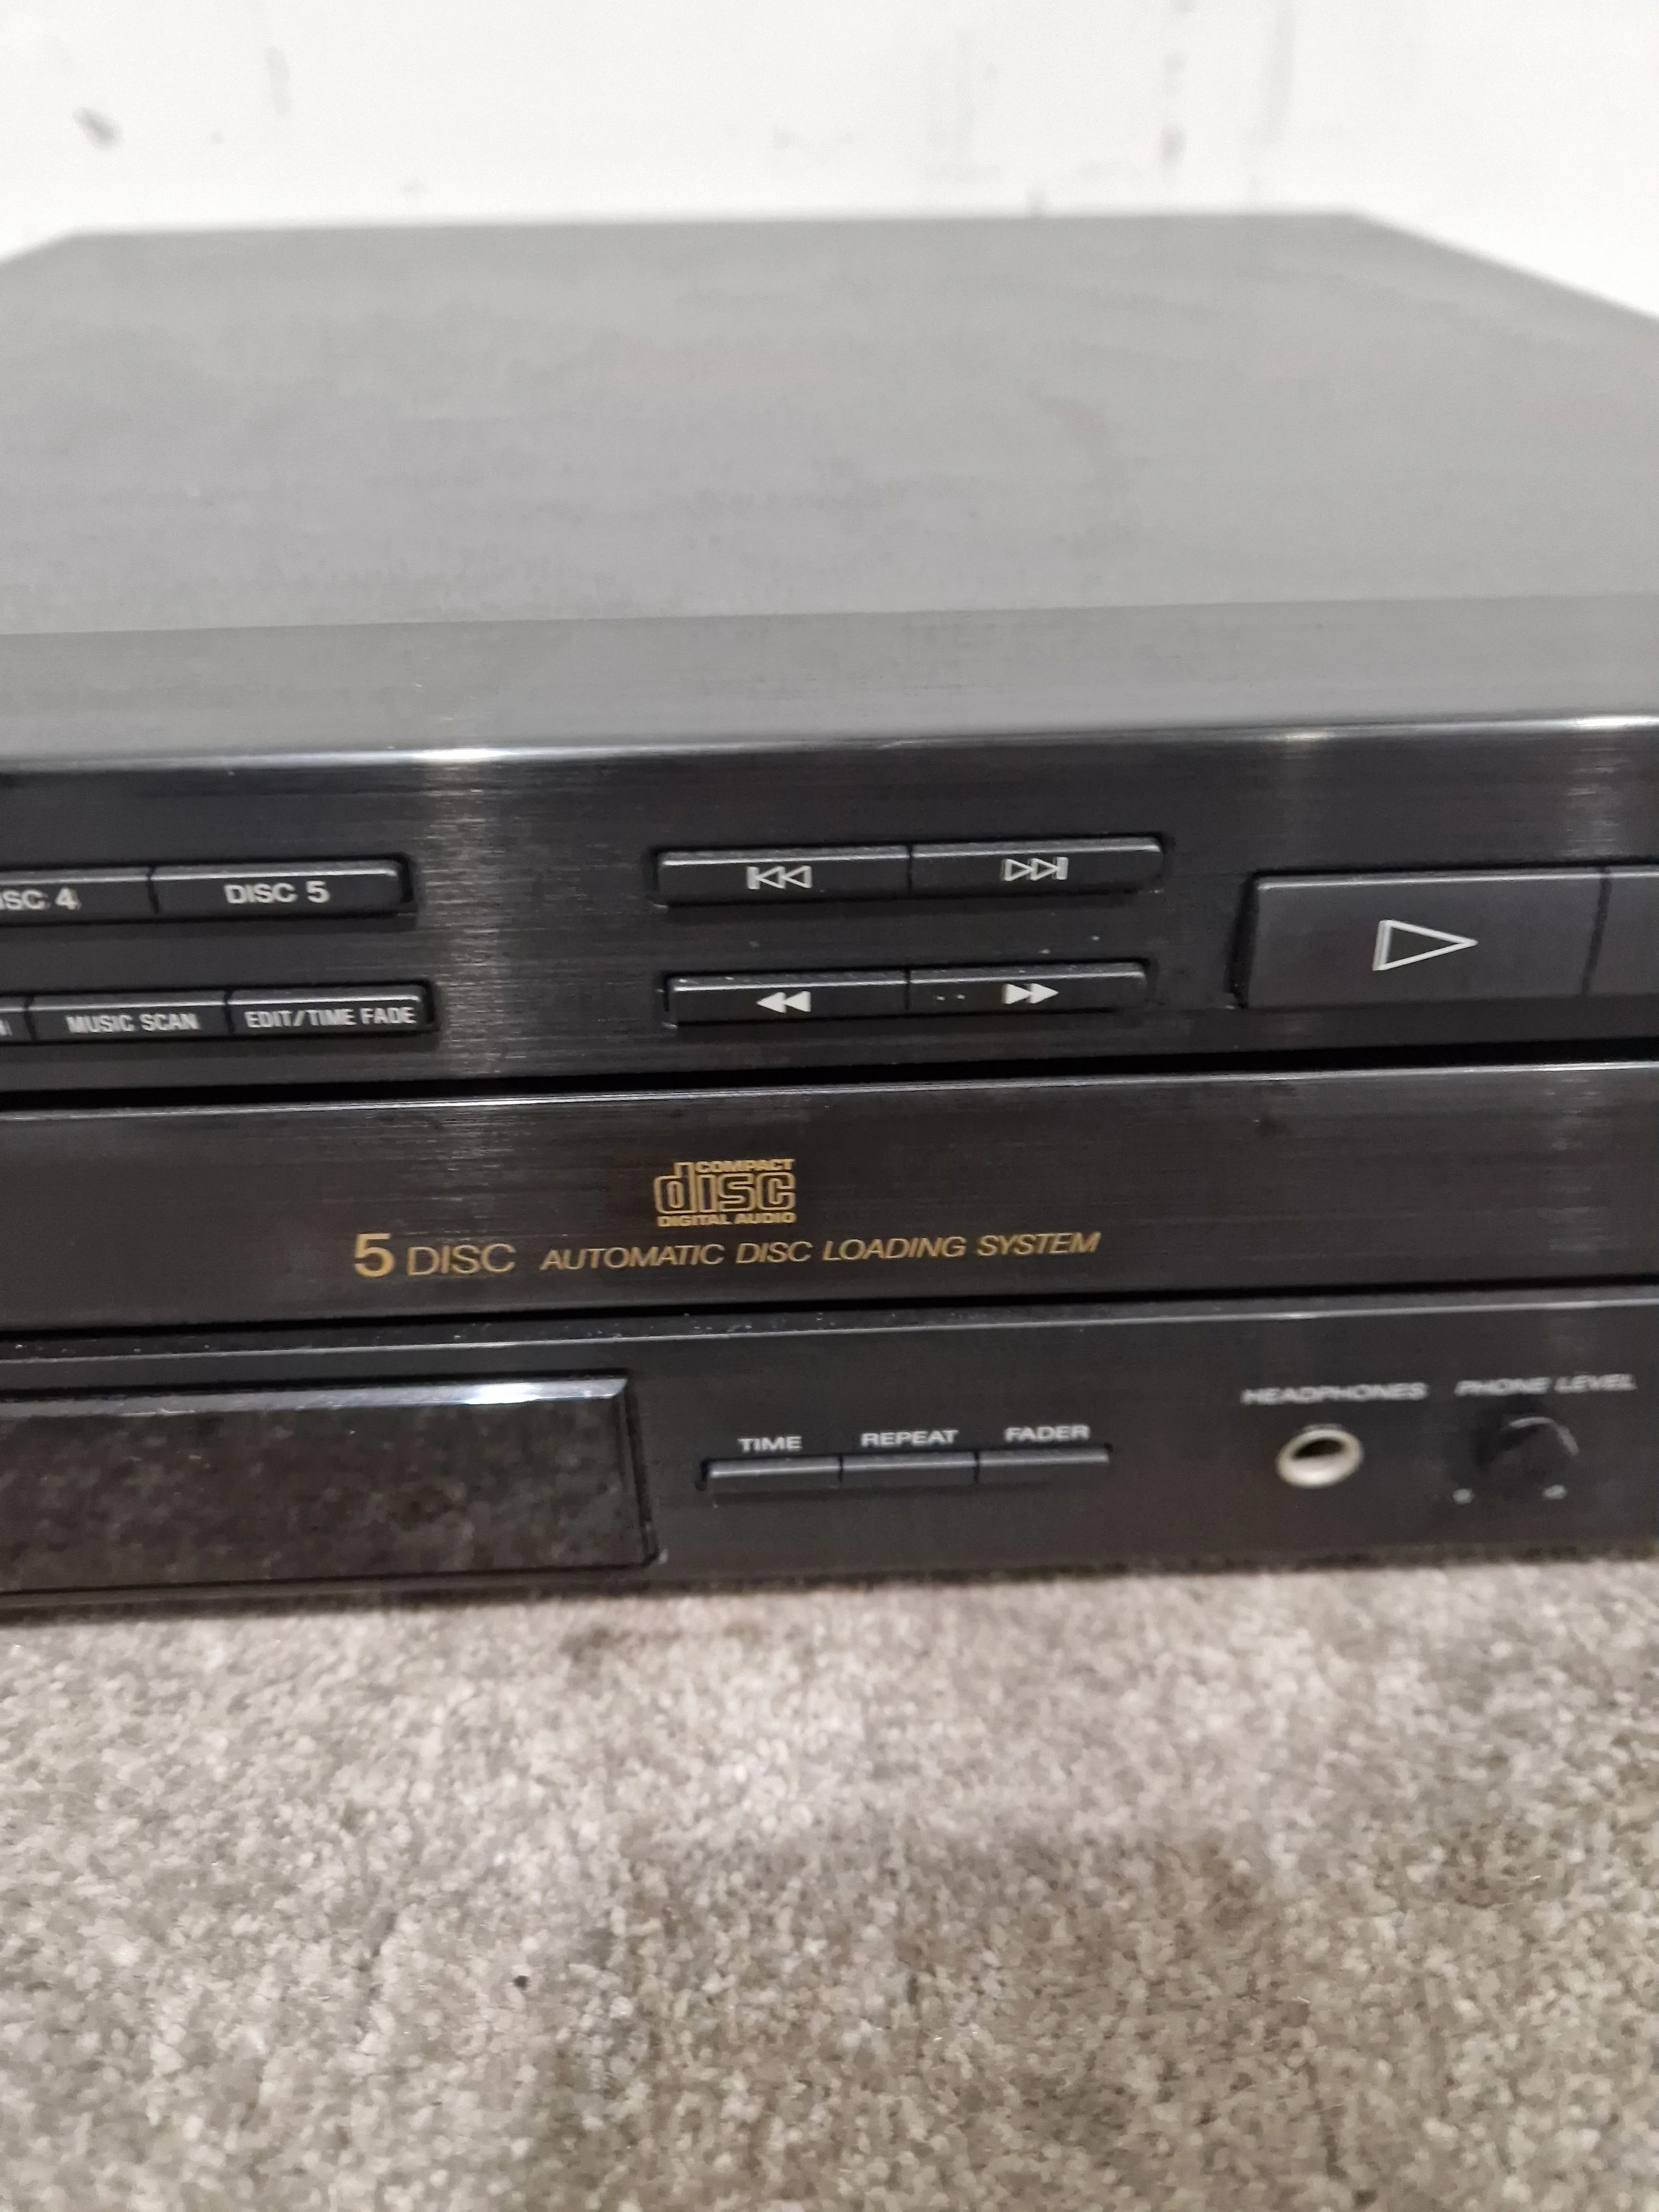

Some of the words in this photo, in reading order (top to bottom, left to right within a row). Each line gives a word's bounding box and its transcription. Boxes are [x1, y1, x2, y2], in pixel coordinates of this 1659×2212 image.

[55, 886, 81, 910] 4
[224, 883, 298, 905] DISC
[306, 880, 331, 904] 5
[65, 1015, 135, 1034] MUSIC
[140, 1013, 200, 1032] SCAN
[244, 1009, 356, 1029] EDIT/TIME
[359, 1006, 418, 1025] FADE
[653, 1162, 796, 1214] disc
[354, 1233, 395, 1278] 5
[407, 1243, 517, 1276] DISC
[539, 1244, 725, 1270] AUTOMATIC
[735, 1240, 814, 1264] DISC
[822, 1235, 967, 1262] LOADING
[977, 1232, 1102, 1257] SYSTEM
[1240, 1382, 1430, 1405] HEADPHONES
[1454, 1378, 1551, 1396] PHONE
[1554, 1373, 1637, 1394] LEVEL
[860, 1429, 959, 1448] REPEAT
[1004, 1423, 1092, 1442] FADER
[737, 1436, 803, 1453] TIME
